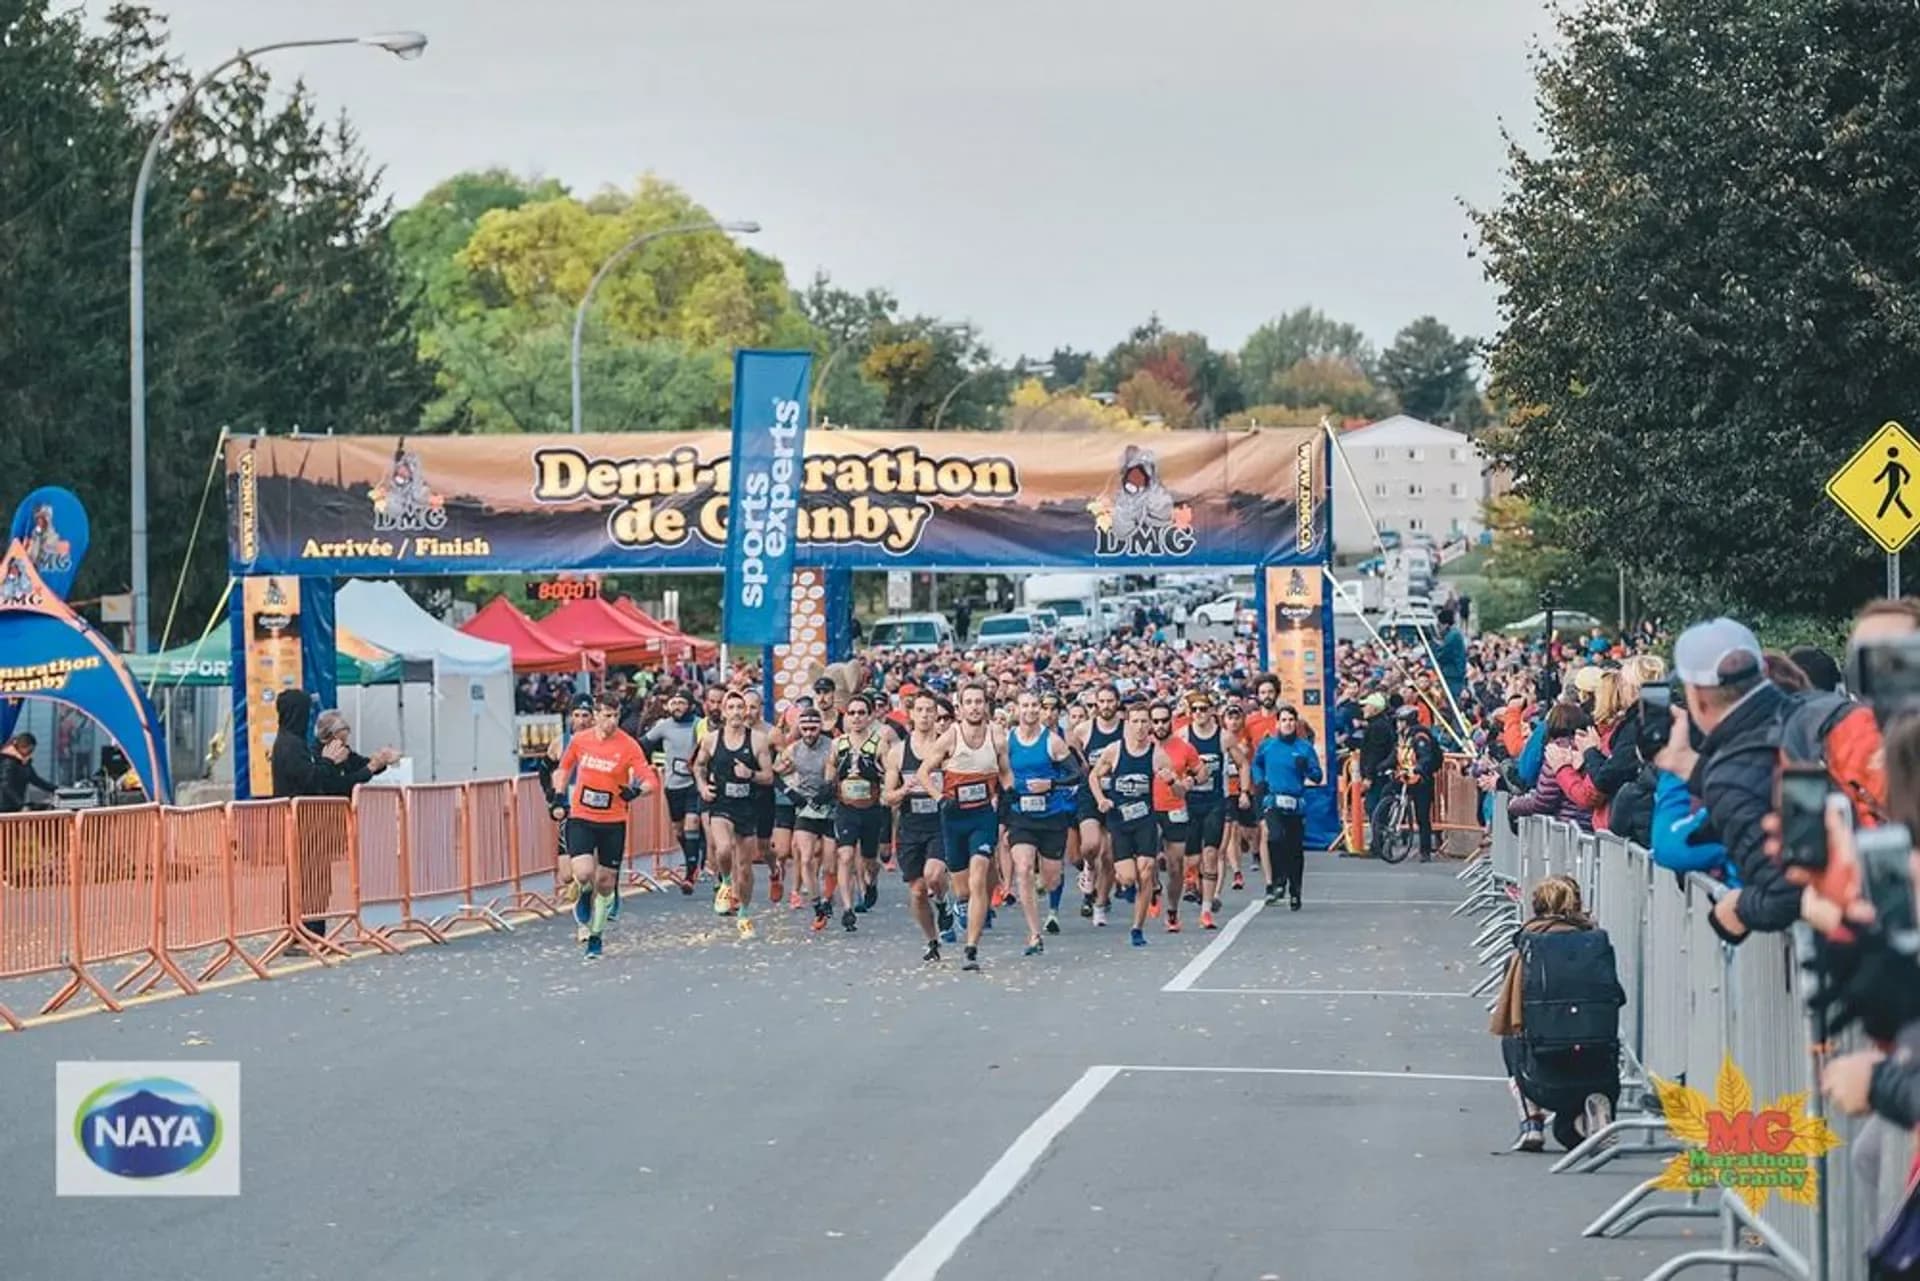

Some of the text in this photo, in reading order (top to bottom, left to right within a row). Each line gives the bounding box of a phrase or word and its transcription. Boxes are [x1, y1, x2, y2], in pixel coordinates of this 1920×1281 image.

[534, 447, 1018, 499] Demi-rathon
[765, 399, 800, 557] experts
[610, 498, 686, 547] de
[741, 471, 770, 609] sports
[1097, 527, 1196, 555] DMG
[302, 535, 491, 560] Arrivée / Finish
[168, 659, 233, 677] SPOR
